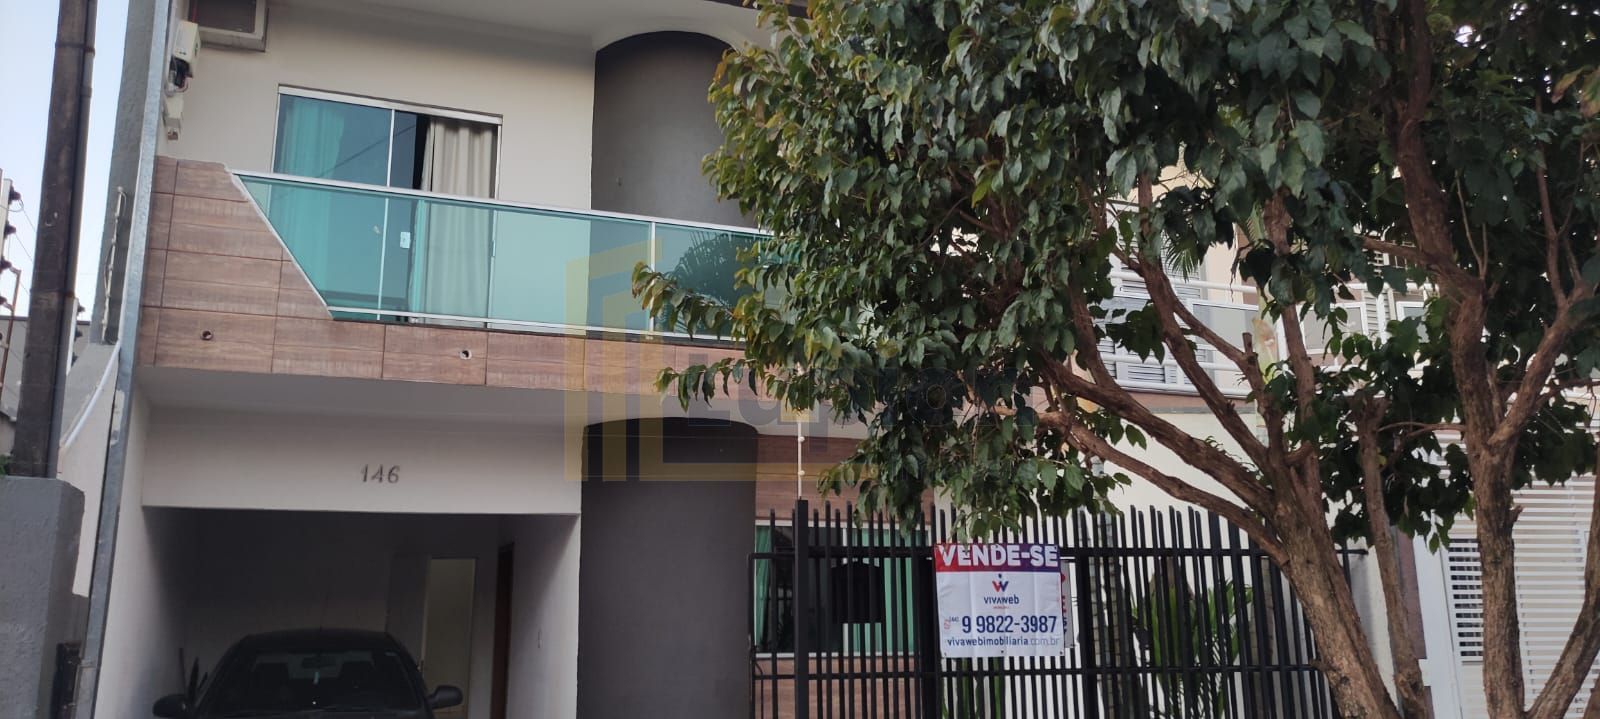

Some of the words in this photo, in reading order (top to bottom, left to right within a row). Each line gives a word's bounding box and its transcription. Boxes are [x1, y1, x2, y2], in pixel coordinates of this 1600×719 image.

[360, 463, 401, 484] 146
[937, 543, 1059, 567] VENDE-SE
[961, 615, 972, 634] 9
[976, 615, 1058, 634] 9822-3987
[946, 636, 1060, 647] vivawebimobiliaria.com.br
